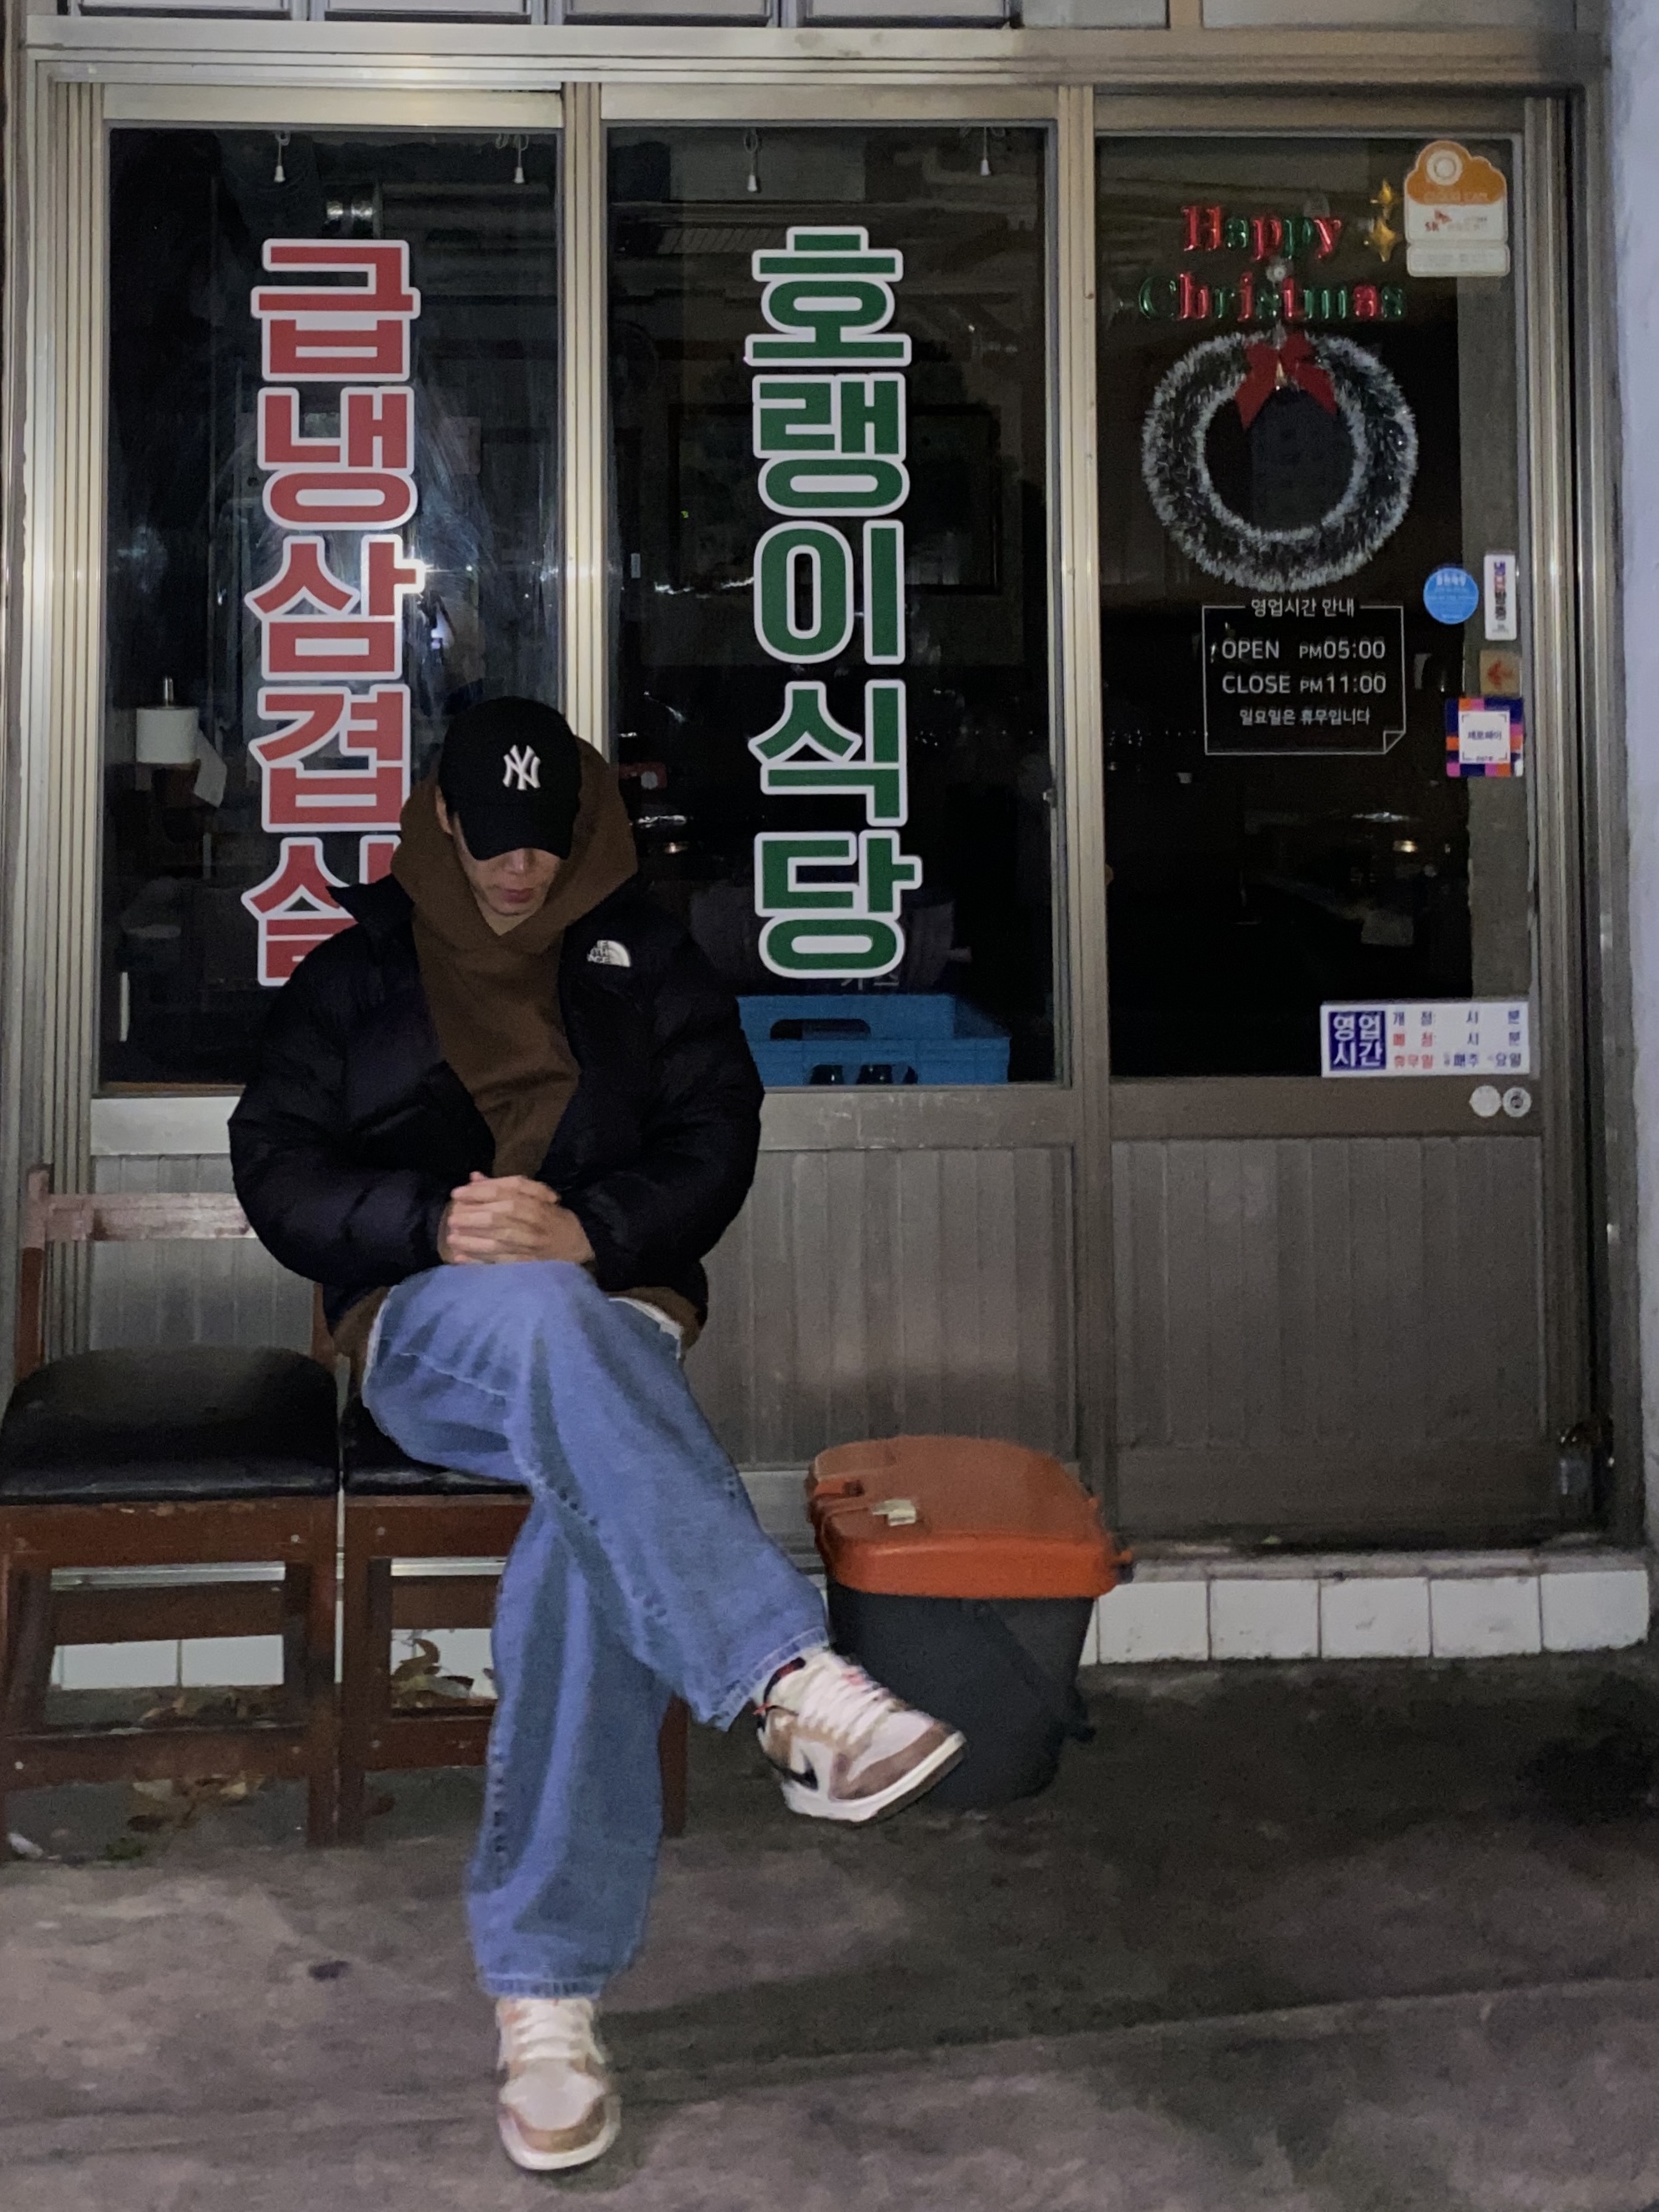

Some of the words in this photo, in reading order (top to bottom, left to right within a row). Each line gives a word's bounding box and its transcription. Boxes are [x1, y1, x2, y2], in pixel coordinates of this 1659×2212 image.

[1182, 205, 1342, 260] Happy
[1138, 273, 1406, 320] Christmas
[1251, 597, 1317, 617] 영업시간
[1322, 597, 1354, 617] 안내
[1222, 641, 1280, 659] OPEN
[1223, 675, 1291, 693] CLOSE
[1239, 708, 1295, 726] 일요일은
[1301, 706, 1370, 725] 휴무입니다
[502, 744, 542, 791] NY
[1333, 1013, 1382, 1040] 영업
[1333, 1040, 1383, 1068] 시간
